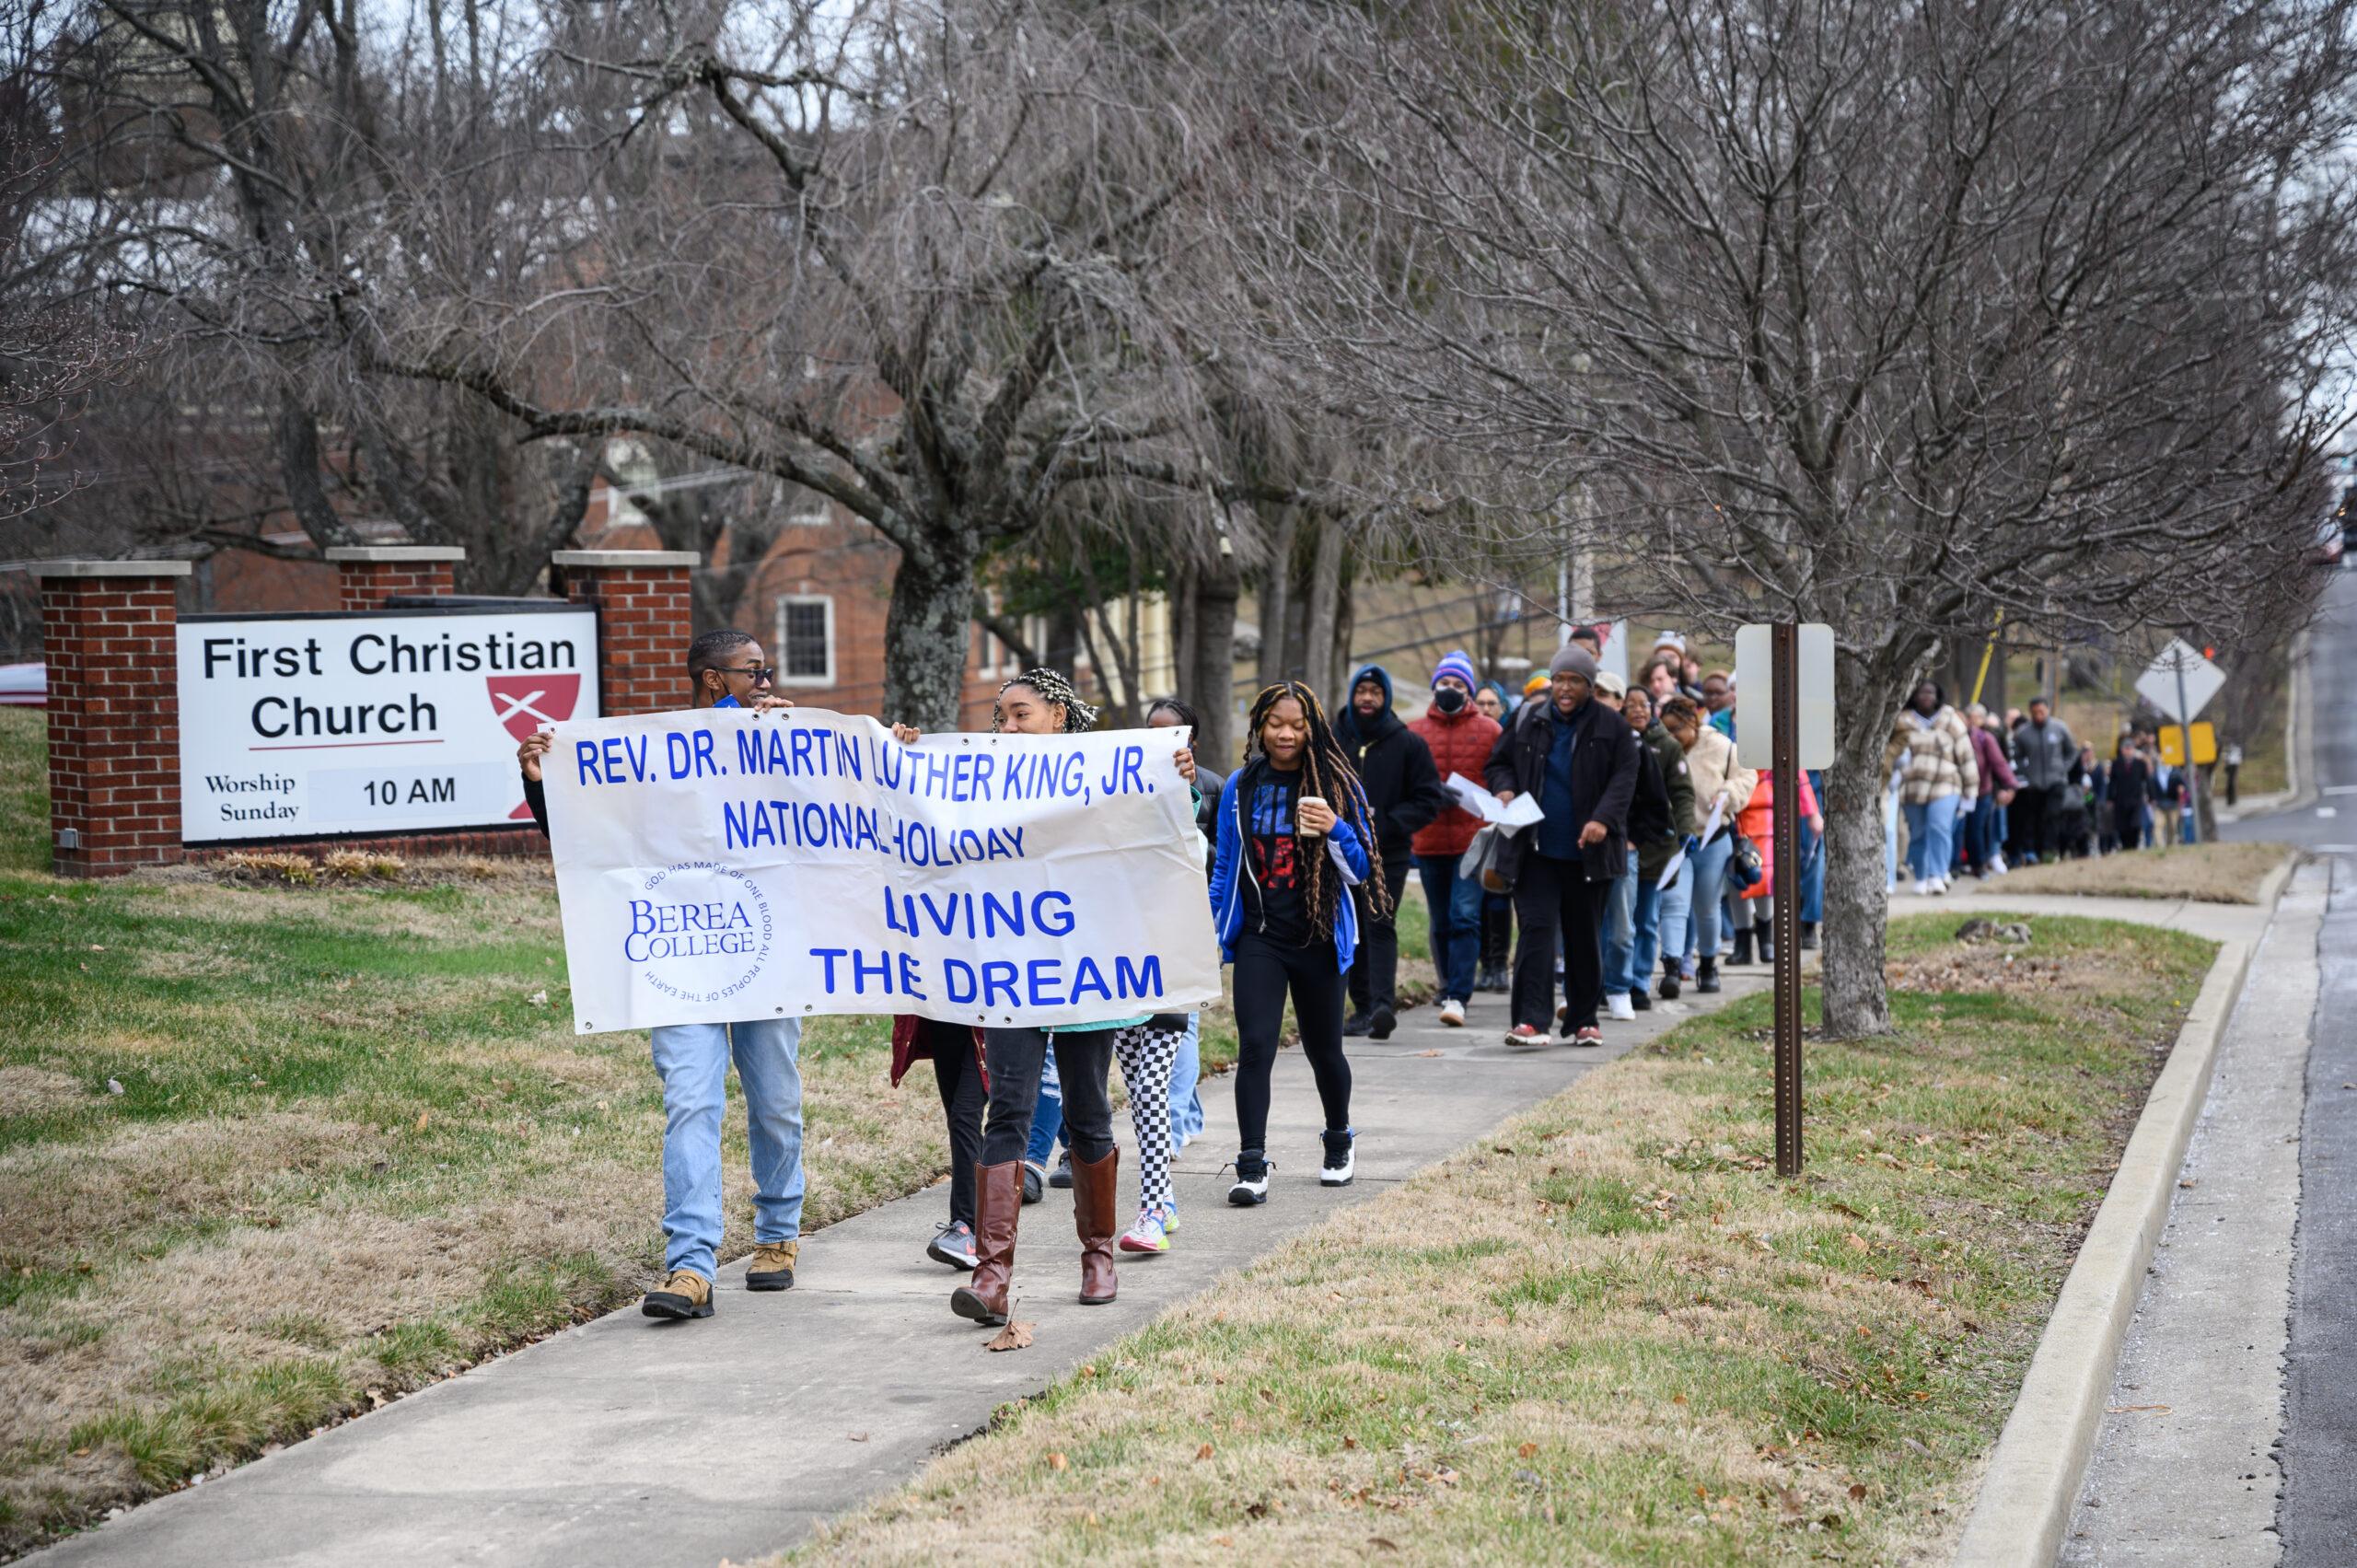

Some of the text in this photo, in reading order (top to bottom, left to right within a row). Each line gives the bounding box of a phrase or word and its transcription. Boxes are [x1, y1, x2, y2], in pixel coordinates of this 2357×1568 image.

[203, 632, 575, 679] First Christian
[251, 692, 437, 738] Church
[205, 773, 296, 795] Worship
[575, 727, 1155, 807] REV. DR. MARTIN LUTHER KING, JR.
[220, 801, 299, 822] Sunday
[364, 777, 456, 806] 10 AM
[724, 799, 1025, 867] NATIONAL HOLIDAY
[628, 899, 753, 935] BEREA
[644, 861, 772, 1002] GOD HAS MADE OF ONE BLOOD ALL PEOPLES OF THE EARTH
[884, 885, 1076, 940] LIVING
[624, 931, 755, 963] COLLEGE
[809, 947, 1164, 1008] THE DREAM
